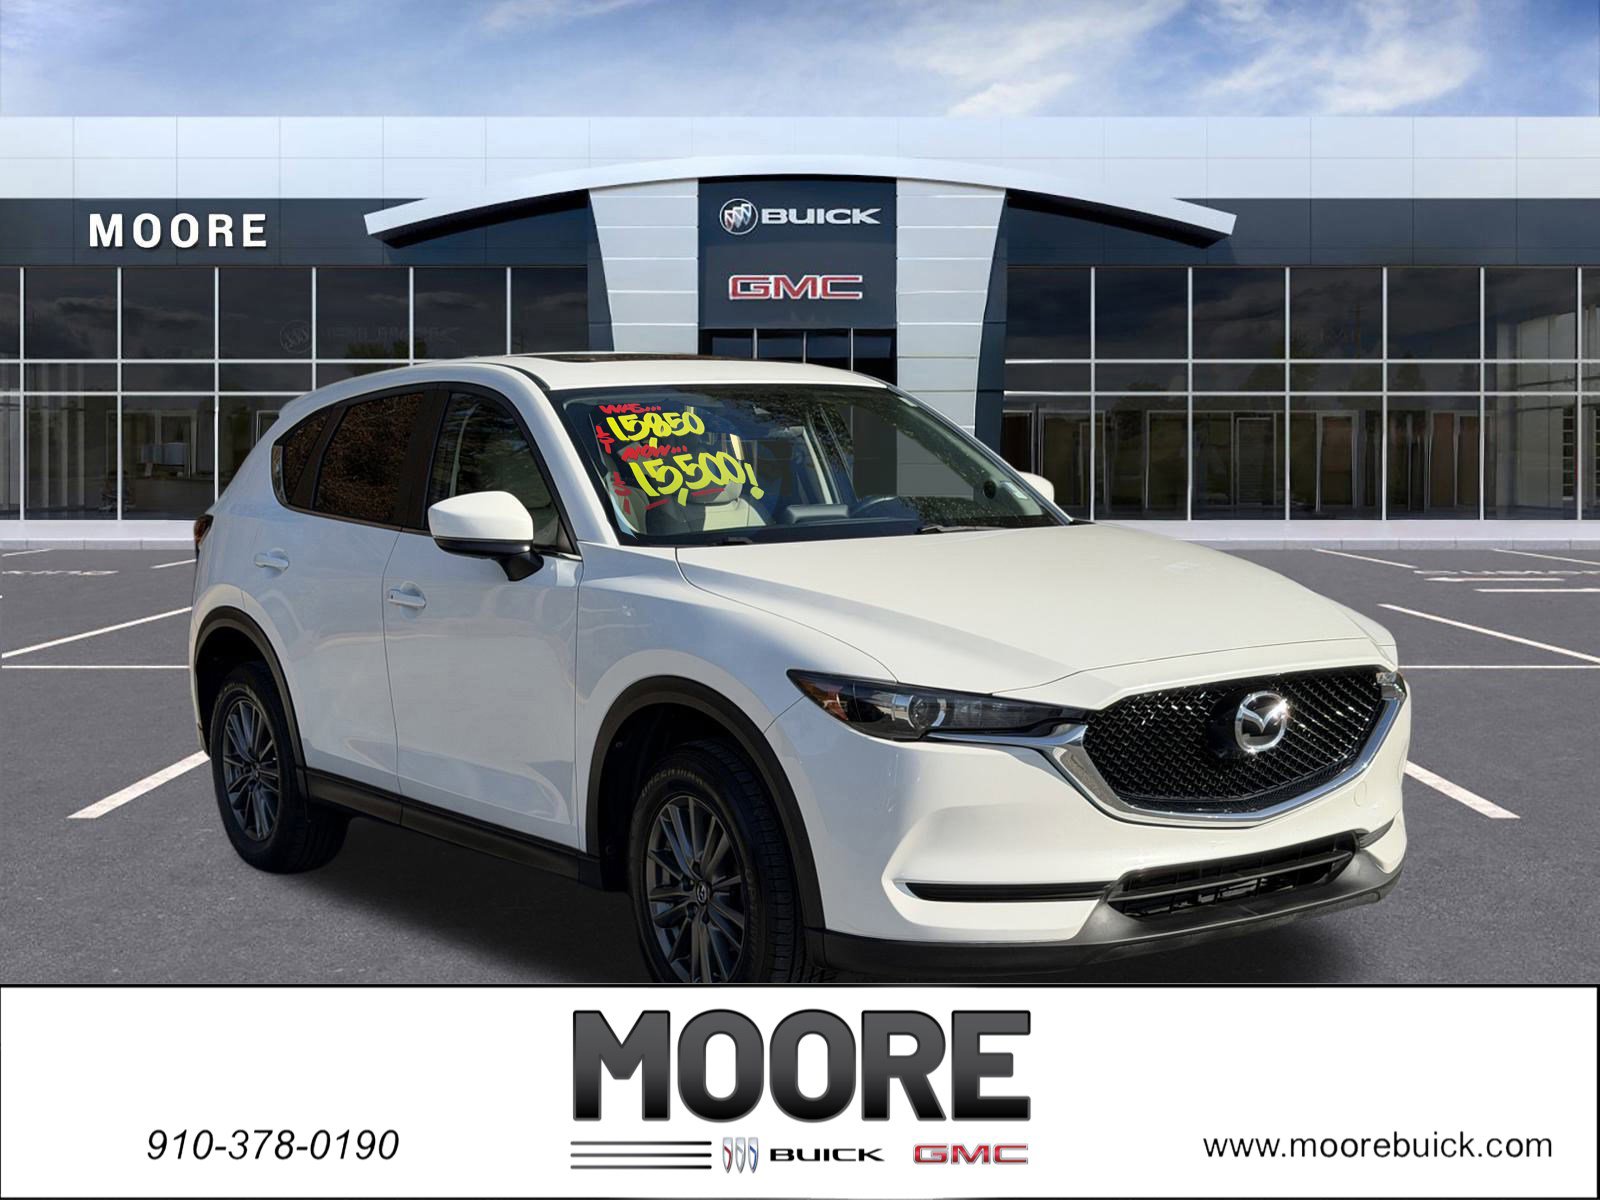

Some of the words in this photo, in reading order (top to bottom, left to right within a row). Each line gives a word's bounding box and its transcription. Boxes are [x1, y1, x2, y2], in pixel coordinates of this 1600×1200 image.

[761, 208, 882, 225] BUICK
[89, 213, 267, 249] MOORE
[729, 274, 863, 300] GMC
